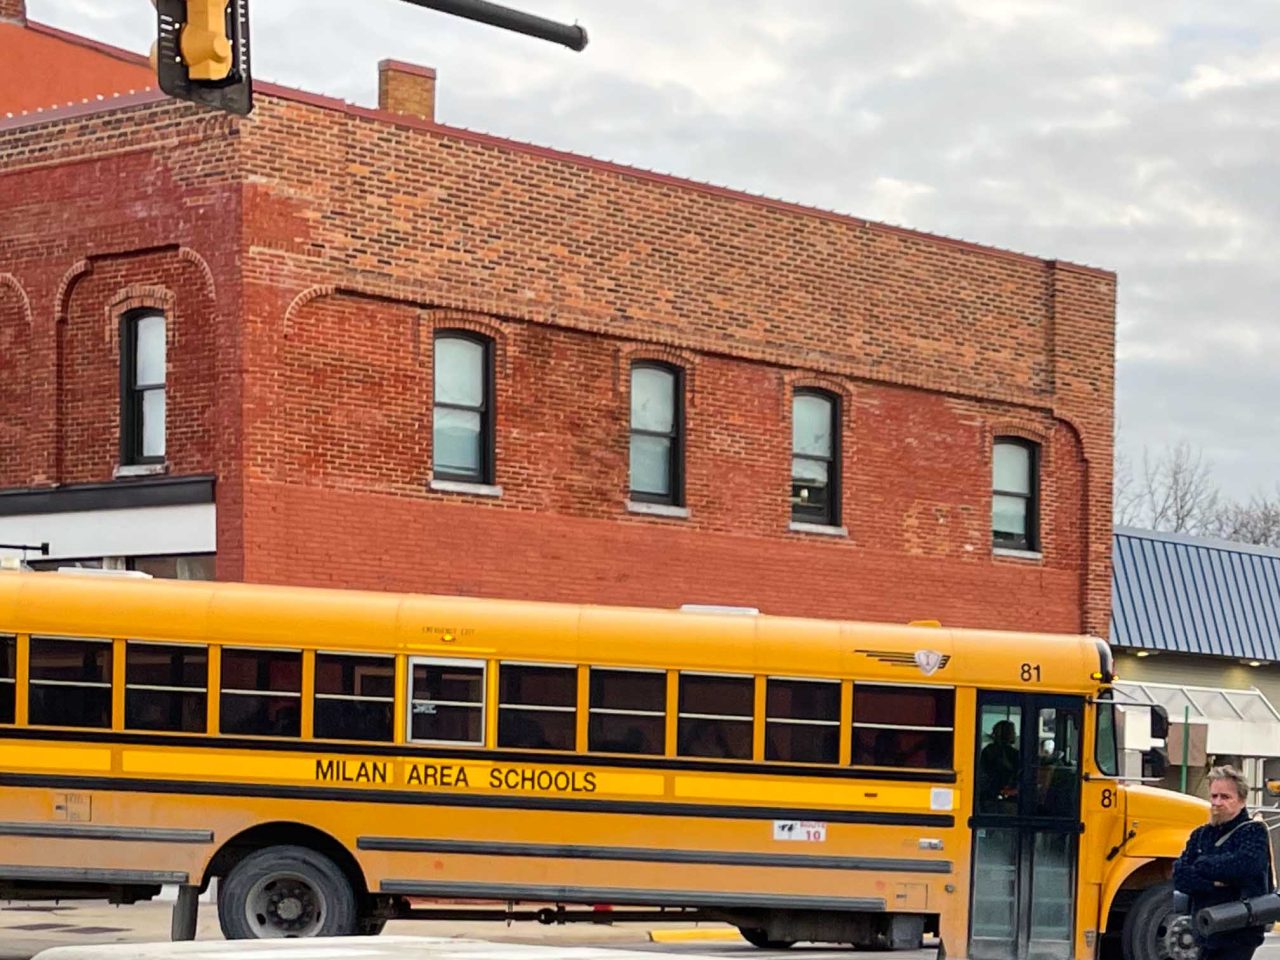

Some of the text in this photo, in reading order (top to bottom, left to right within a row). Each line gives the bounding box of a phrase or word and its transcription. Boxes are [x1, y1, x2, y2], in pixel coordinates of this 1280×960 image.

[1020, 663, 1041, 682] 81
[315, 760, 597, 792] MILAN AREA SCHOOLS
[1101, 788, 1118, 808] 81
[806, 830, 821, 841] 10
